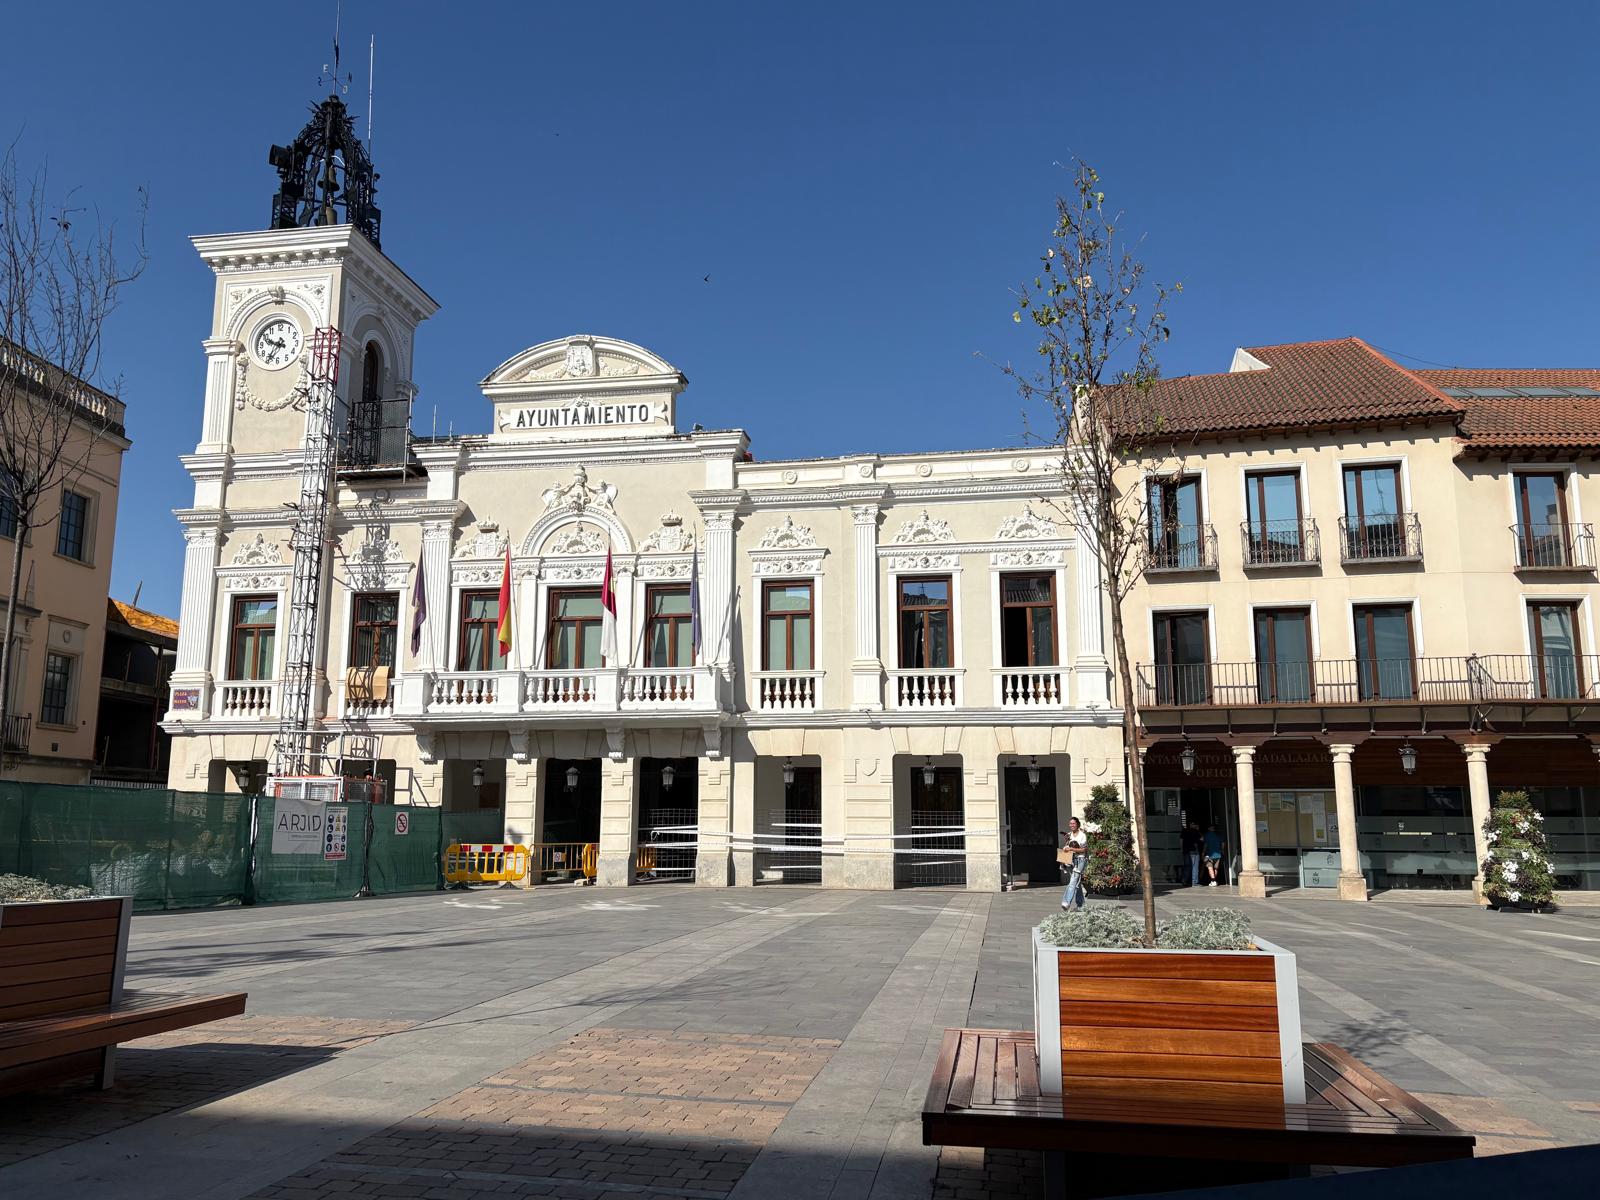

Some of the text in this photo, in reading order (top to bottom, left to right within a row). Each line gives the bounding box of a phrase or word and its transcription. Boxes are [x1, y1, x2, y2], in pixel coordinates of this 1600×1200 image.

[260, 341, 264, 349] 9
[516, 404, 649, 428] AYUNTAMIENTO
[1196, 767, 1261, 778] OFICIS
[278, 813, 322, 831] ARJID
